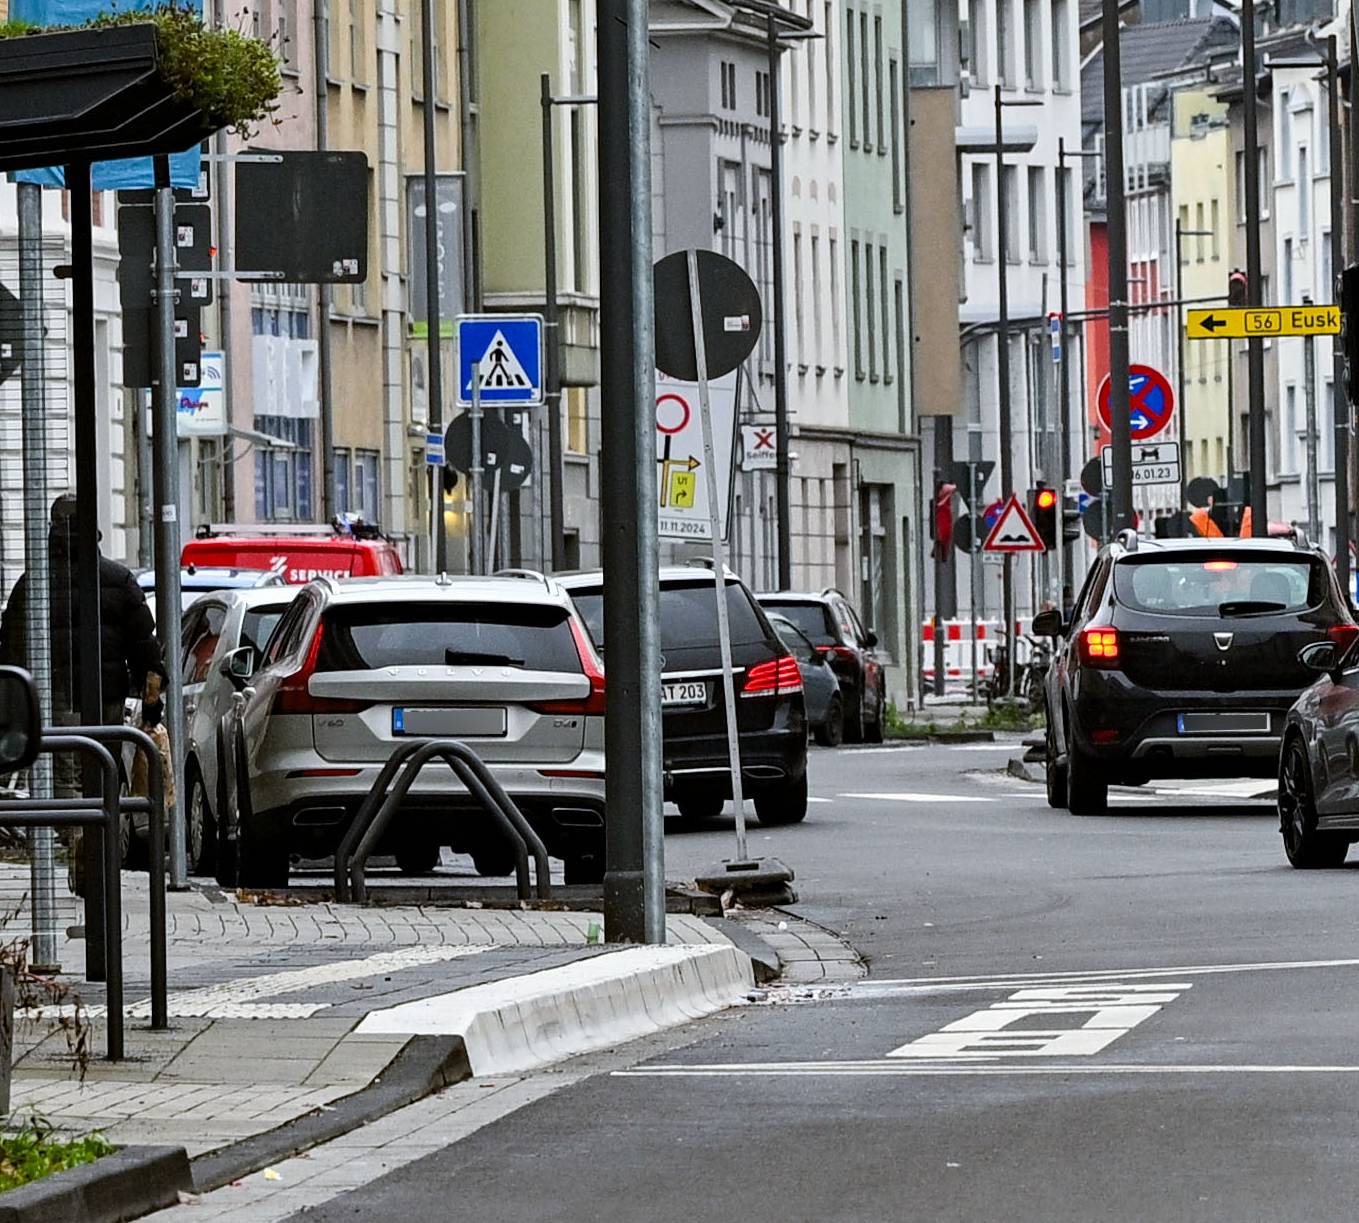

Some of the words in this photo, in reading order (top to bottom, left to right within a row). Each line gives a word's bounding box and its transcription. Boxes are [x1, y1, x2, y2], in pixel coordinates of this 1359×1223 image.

[1253, 315, 1273, 329] 56
[1291, 311, 1338, 328] Eusk
[1132, 467, 1171, 480] 6.01.23
[679, 684, 704, 700] 203
